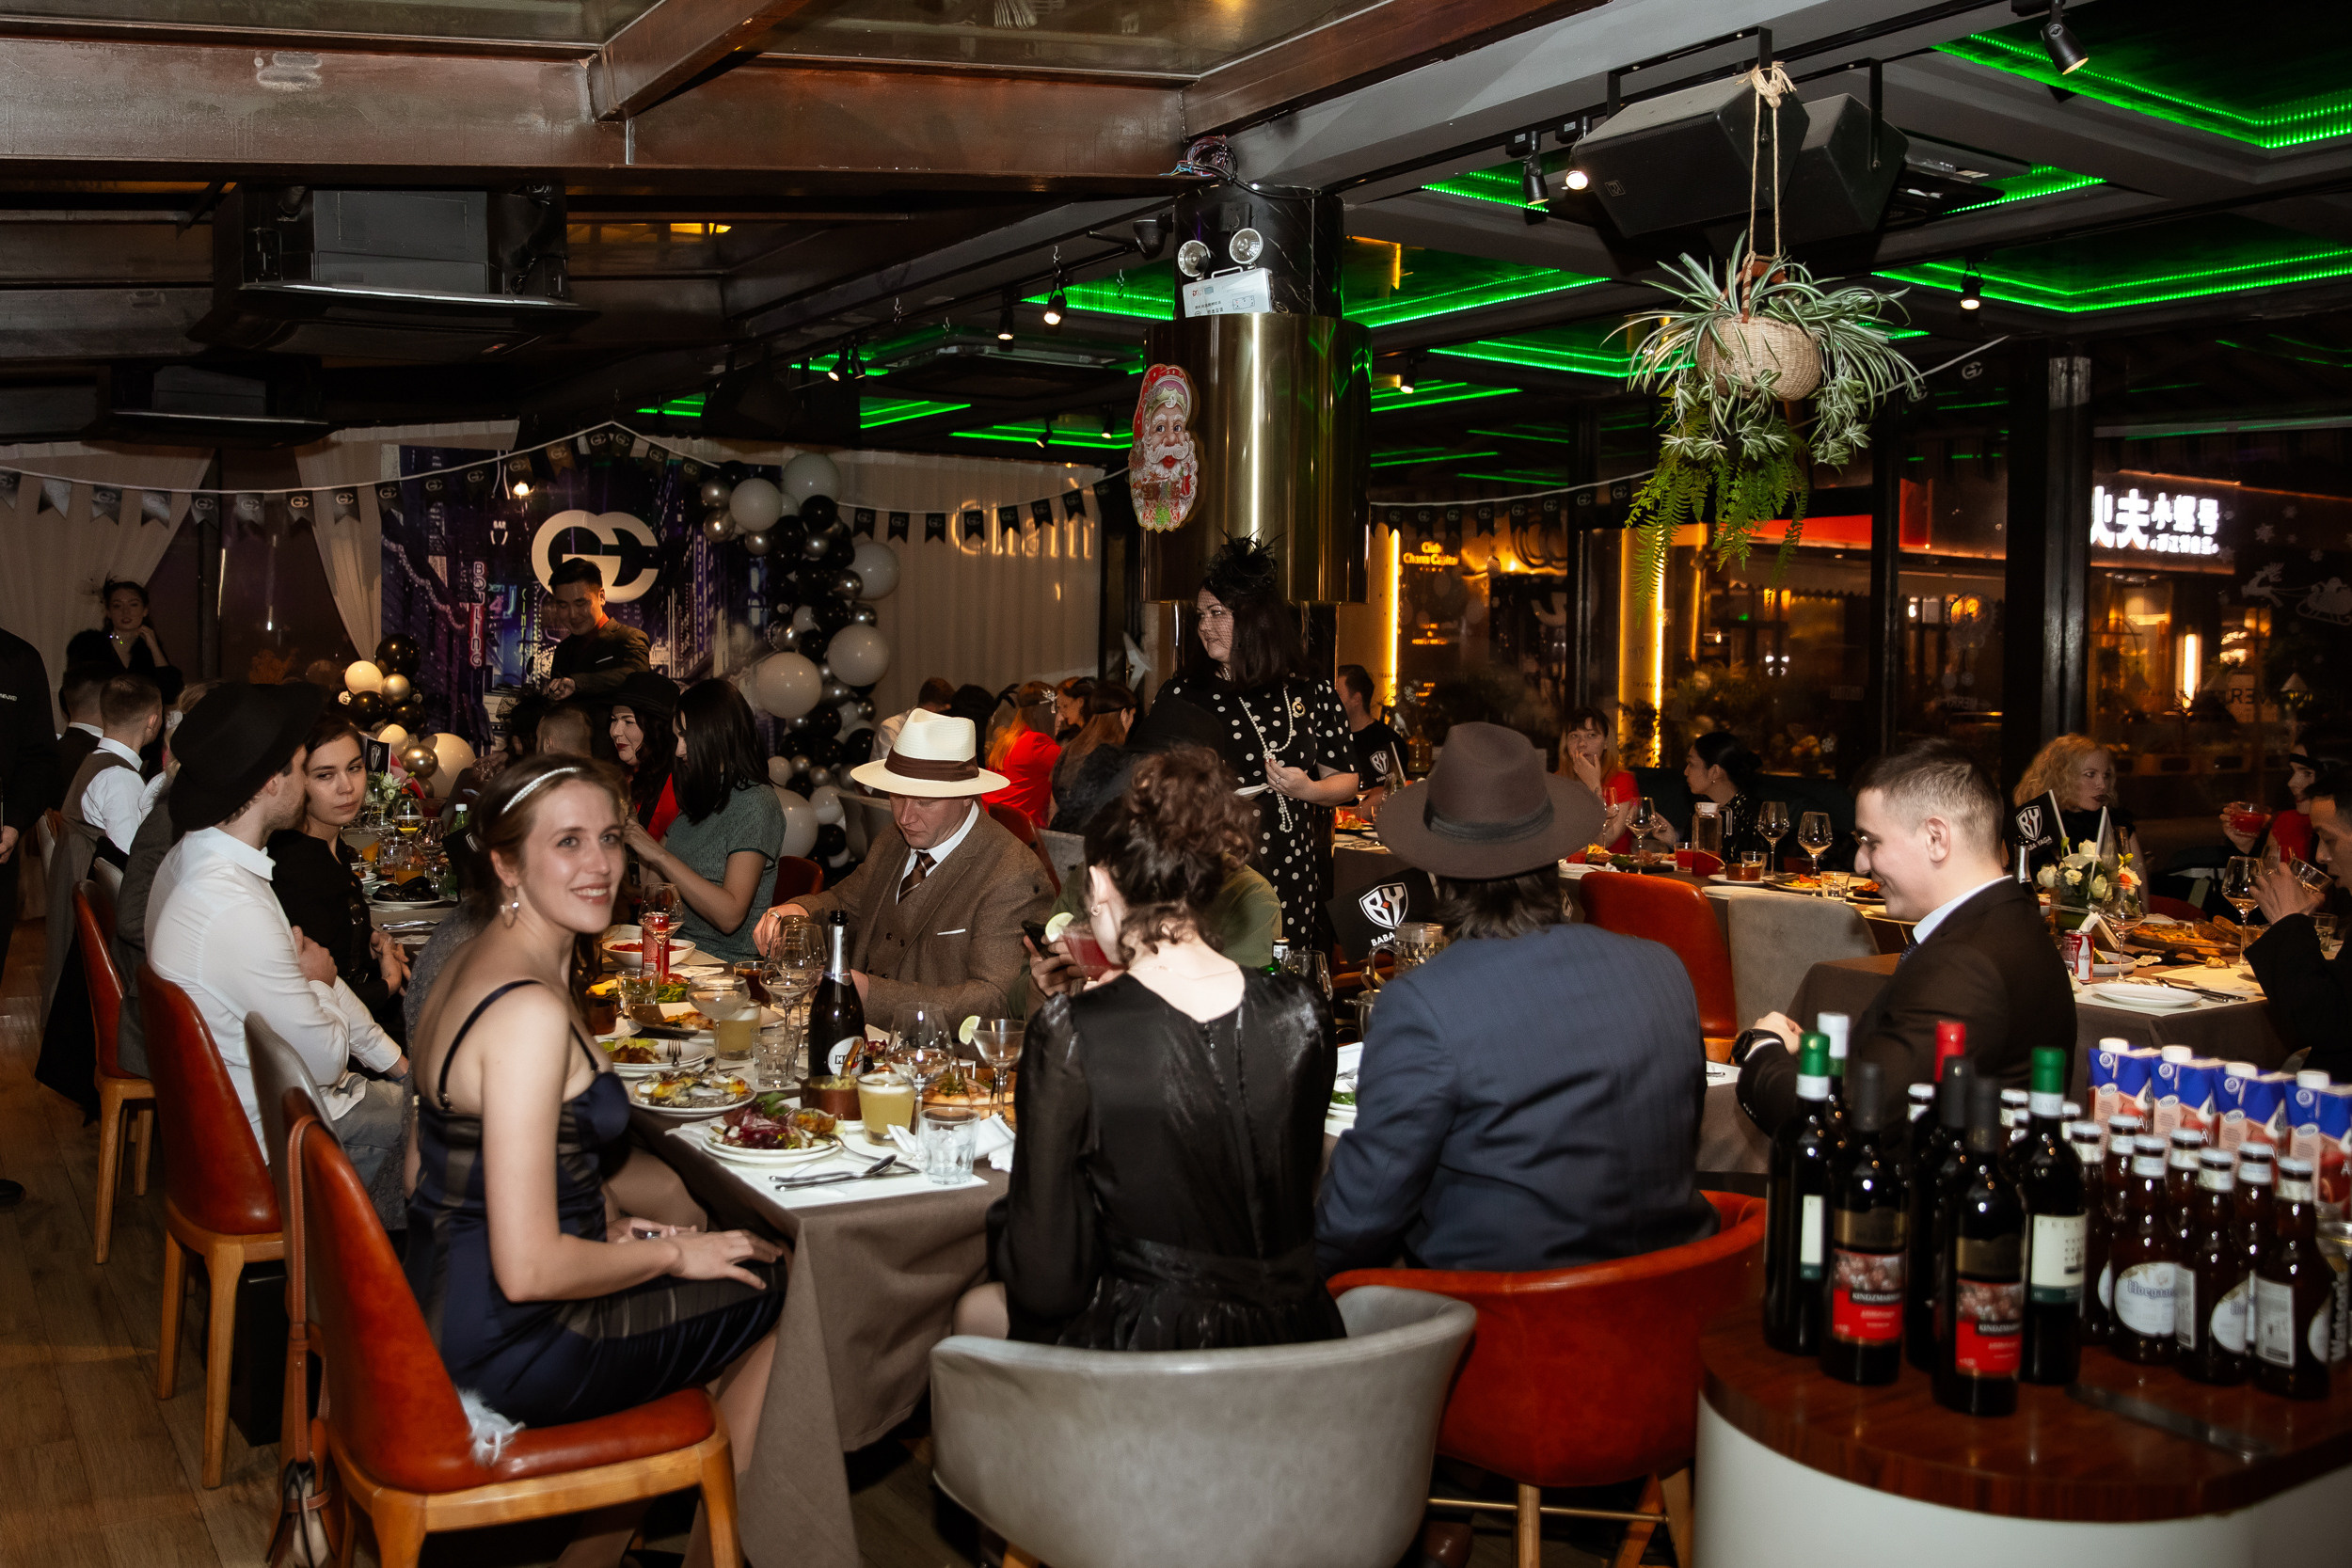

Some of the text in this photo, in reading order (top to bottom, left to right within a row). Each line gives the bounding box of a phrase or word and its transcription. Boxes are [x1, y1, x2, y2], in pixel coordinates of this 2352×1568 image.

[1962, 362, 1983, 380] GC
[590, 434, 607, 447] GC
[615, 434, 630, 447] GC
[467, 470, 485, 483] GC
[425, 479, 443, 492] GC
[335, 493, 355, 505] GC
[379, 486, 397, 499] GC
[195, 498, 215, 510] GC
[290, 496, 310, 508] GC
[1422, 541, 1442, 553] Club
[532, 509, 660, 604] GC
[1372, 752, 1387, 772] BY
[2018, 808, 2040, 839] BY
[1362, 886, 1405, 927] BY
[1371, 931, 1395, 947] BABA
[2127, 1280, 2175, 1300] Hoegaar
